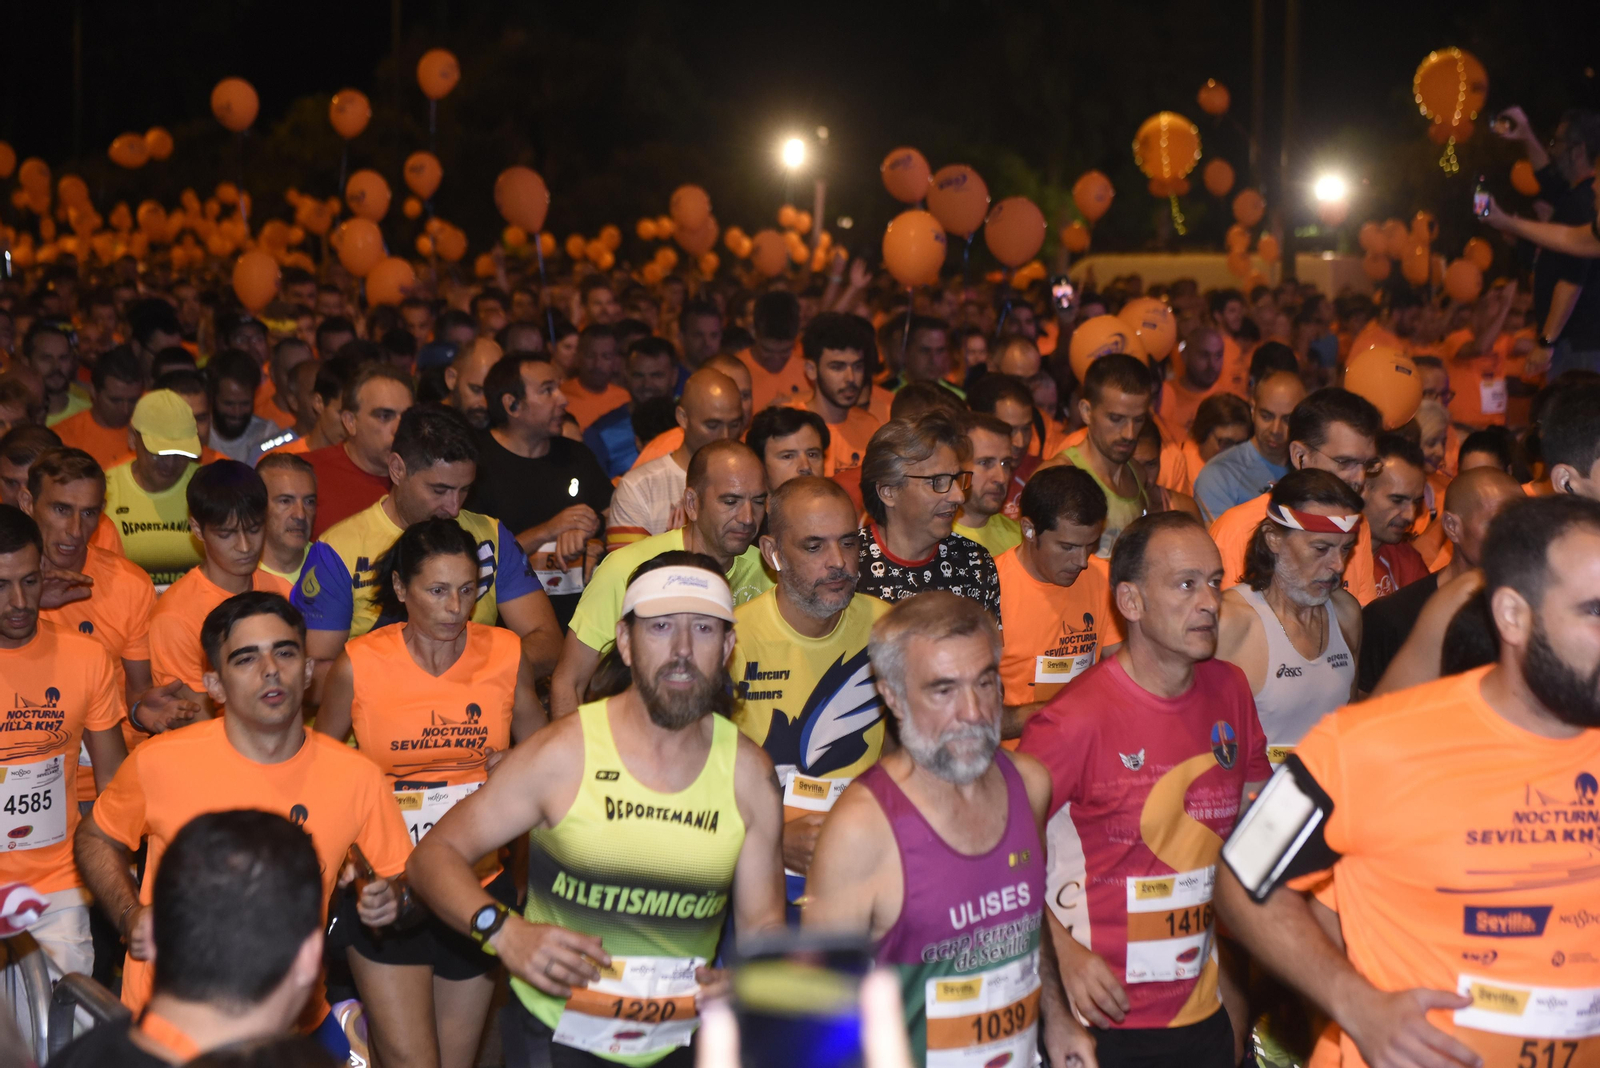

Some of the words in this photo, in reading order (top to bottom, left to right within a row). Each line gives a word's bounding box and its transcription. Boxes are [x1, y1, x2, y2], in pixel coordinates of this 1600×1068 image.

[1059, 633, 1097, 645] NOCTURNA
[1044, 645, 1078, 657] SEVILLA
[744, 661, 790, 681] Mercury
[7, 710, 65, 719] NOCTURNA
[421, 726, 488, 737] NOCTURNA
[390, 739, 451, 751] SEVILLA
[3, 789, 53, 816] 4585
[605, 796, 720, 834] DEPORTEMANIA
[1512, 810, 1600, 824] NOCTURN
[1466, 828, 1557, 845] SEVILLA
[949, 881, 1031, 931] ULISES
[1165, 904, 1212, 937] 1416
[954, 949, 978, 973] de
[979, 931, 1030, 967] Sevilla
[611, 996, 676, 1023] 1220
[971, 1003, 1026, 1044] 1039
[1518, 1041, 1579, 1068] 517
